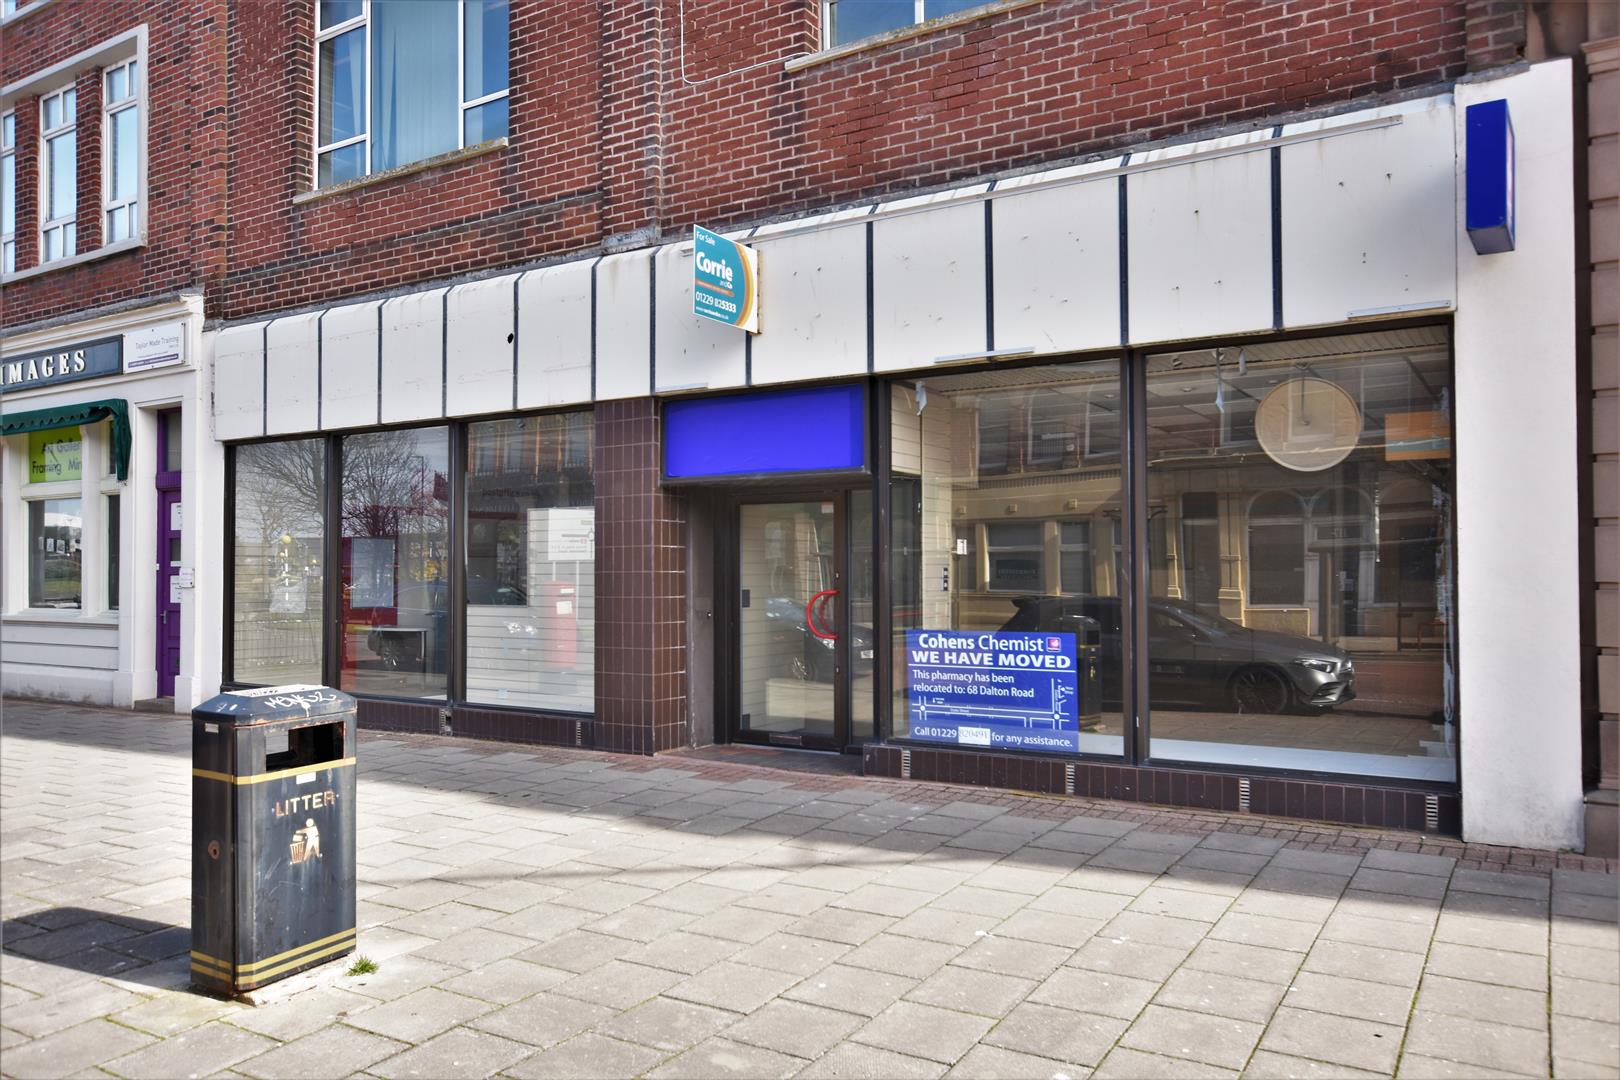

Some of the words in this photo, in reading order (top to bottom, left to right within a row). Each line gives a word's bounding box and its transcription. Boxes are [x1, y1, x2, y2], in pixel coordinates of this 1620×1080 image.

[696, 231, 704, 241] For
[705, 235, 715, 245] Sale
[696, 252, 733, 281] Corrie
[695, 291, 713, 306] 01229
[0, 349, 86, 385] IMAGES
[32, 460, 62, 476] Framing
[918, 633, 975, 650] Cohens
[978, 635, 1044, 652] Chemist
[912, 650, 940, 664] WE
[944, 652, 994, 666] HAVE
[999, 653, 1071, 669] MOVED
[912, 669, 930, 681] This
[931, 671, 973, 684] pharmacy
[974, 672, 990, 683] has
[992, 672, 1015, 684] been
[913, 683, 953, 694] relocated
[954, 685, 966, 695] to:
[967, 686, 978, 695] 68
[980, 686, 1009, 697] Dalton
[1011, 687, 1035, 698] Road
[914, 726, 931, 737] Call
[932, 727, 957, 739] 01229
[991, 731, 1004, 742] for
[1006, 734, 1022, 744] any
[1024, 735, 1073, 748] assistance.
[274, 791, 336, 817] LITTER
